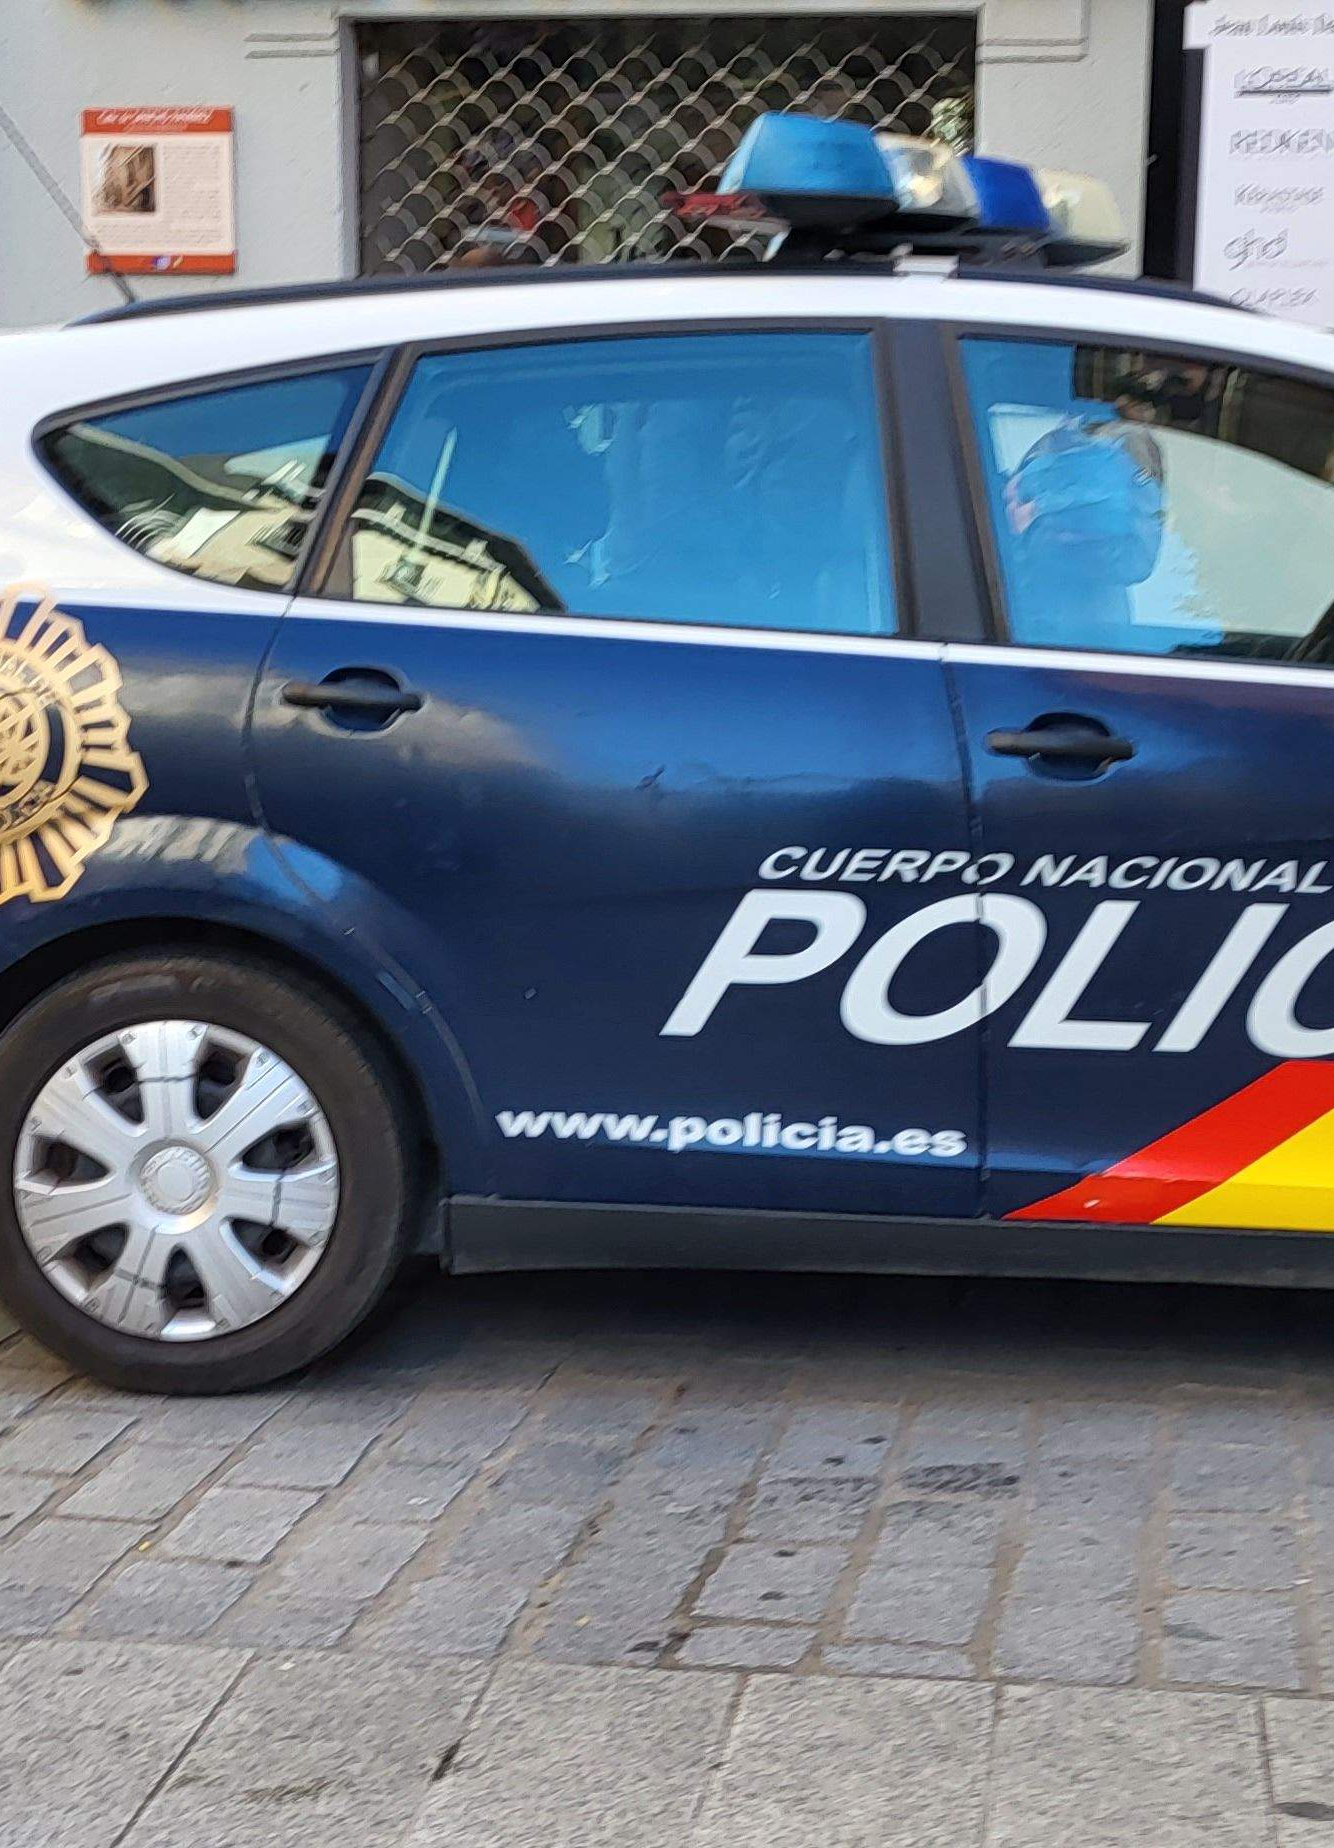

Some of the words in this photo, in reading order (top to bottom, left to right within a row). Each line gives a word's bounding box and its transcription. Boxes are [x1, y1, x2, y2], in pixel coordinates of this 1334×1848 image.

[758, 846, 1015, 886] CUERPO
[1019, 854, 1334, 894] NACIONAL
[495, 1110, 968, 1158] www.policia.es
